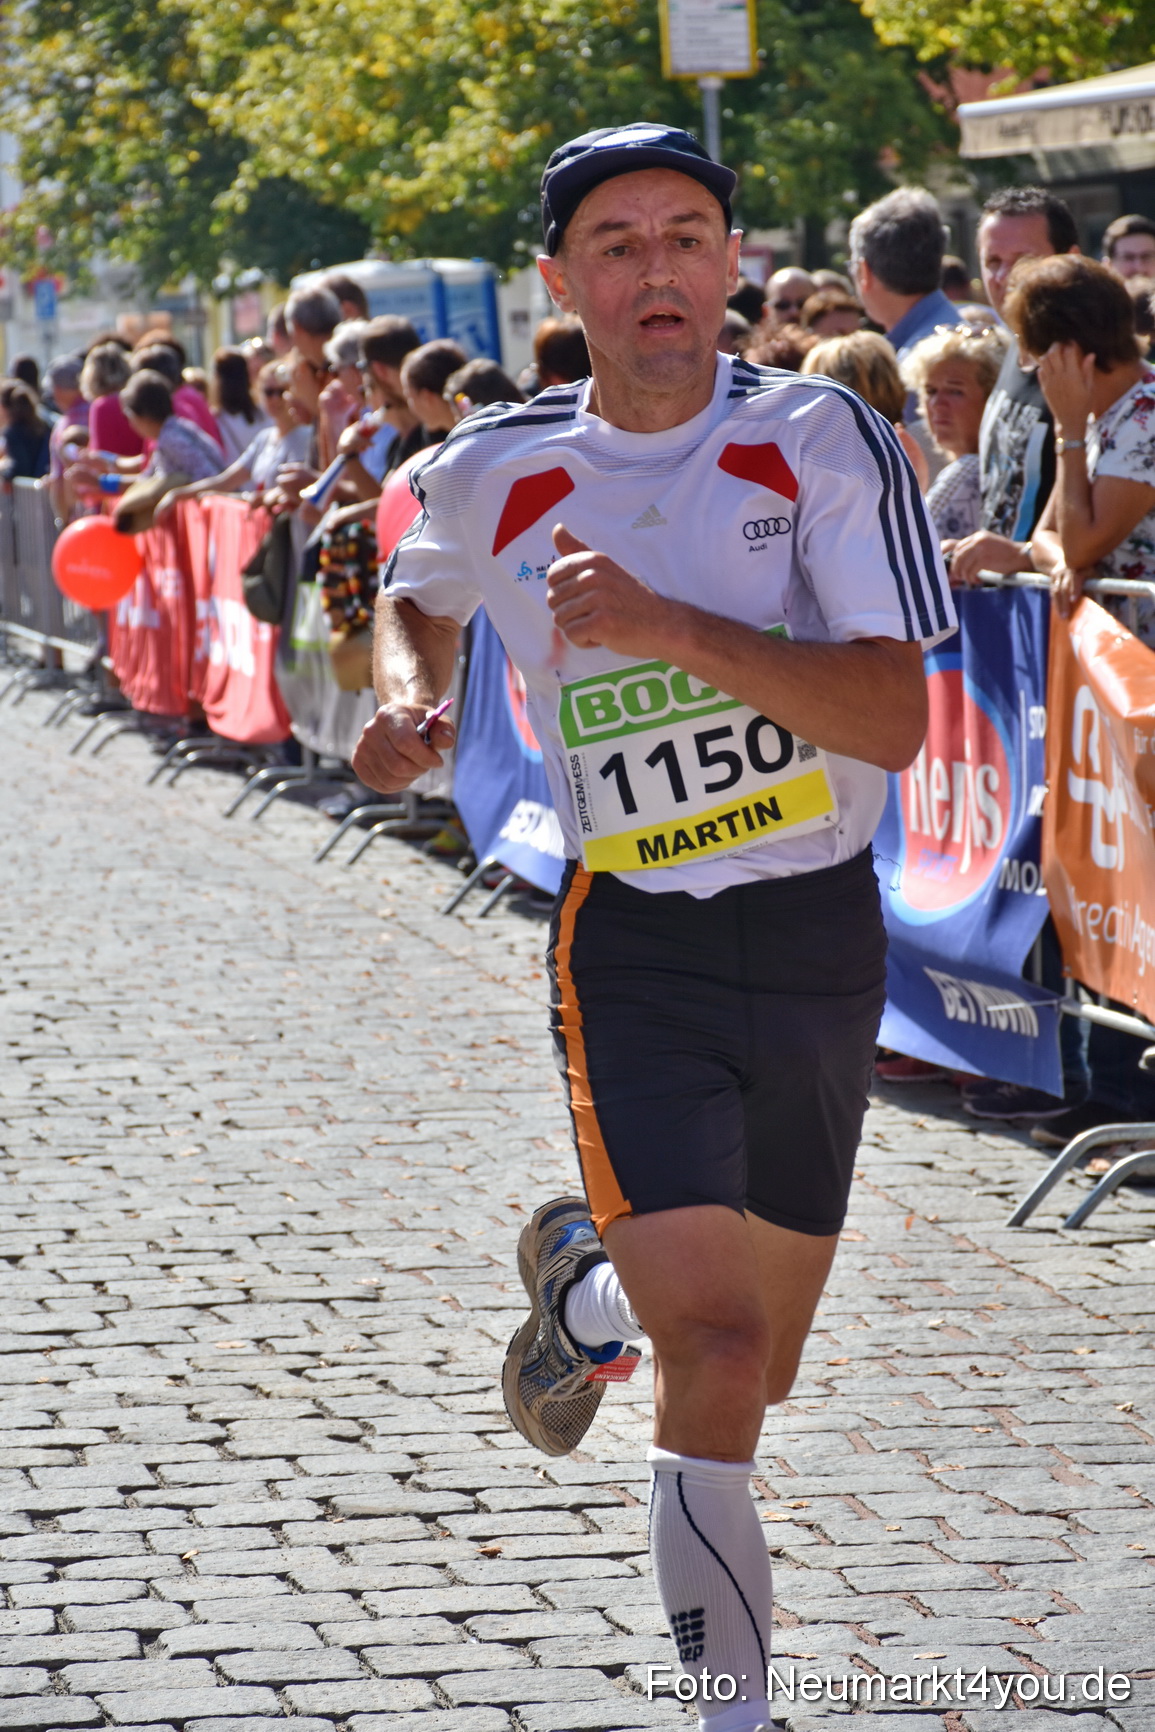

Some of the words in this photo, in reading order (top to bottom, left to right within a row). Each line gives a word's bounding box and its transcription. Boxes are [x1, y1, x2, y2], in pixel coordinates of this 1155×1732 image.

[748, 543, 768, 553] Audi
[599, 714, 795, 815] 1150
[636, 796, 783, 865] MARTIN
